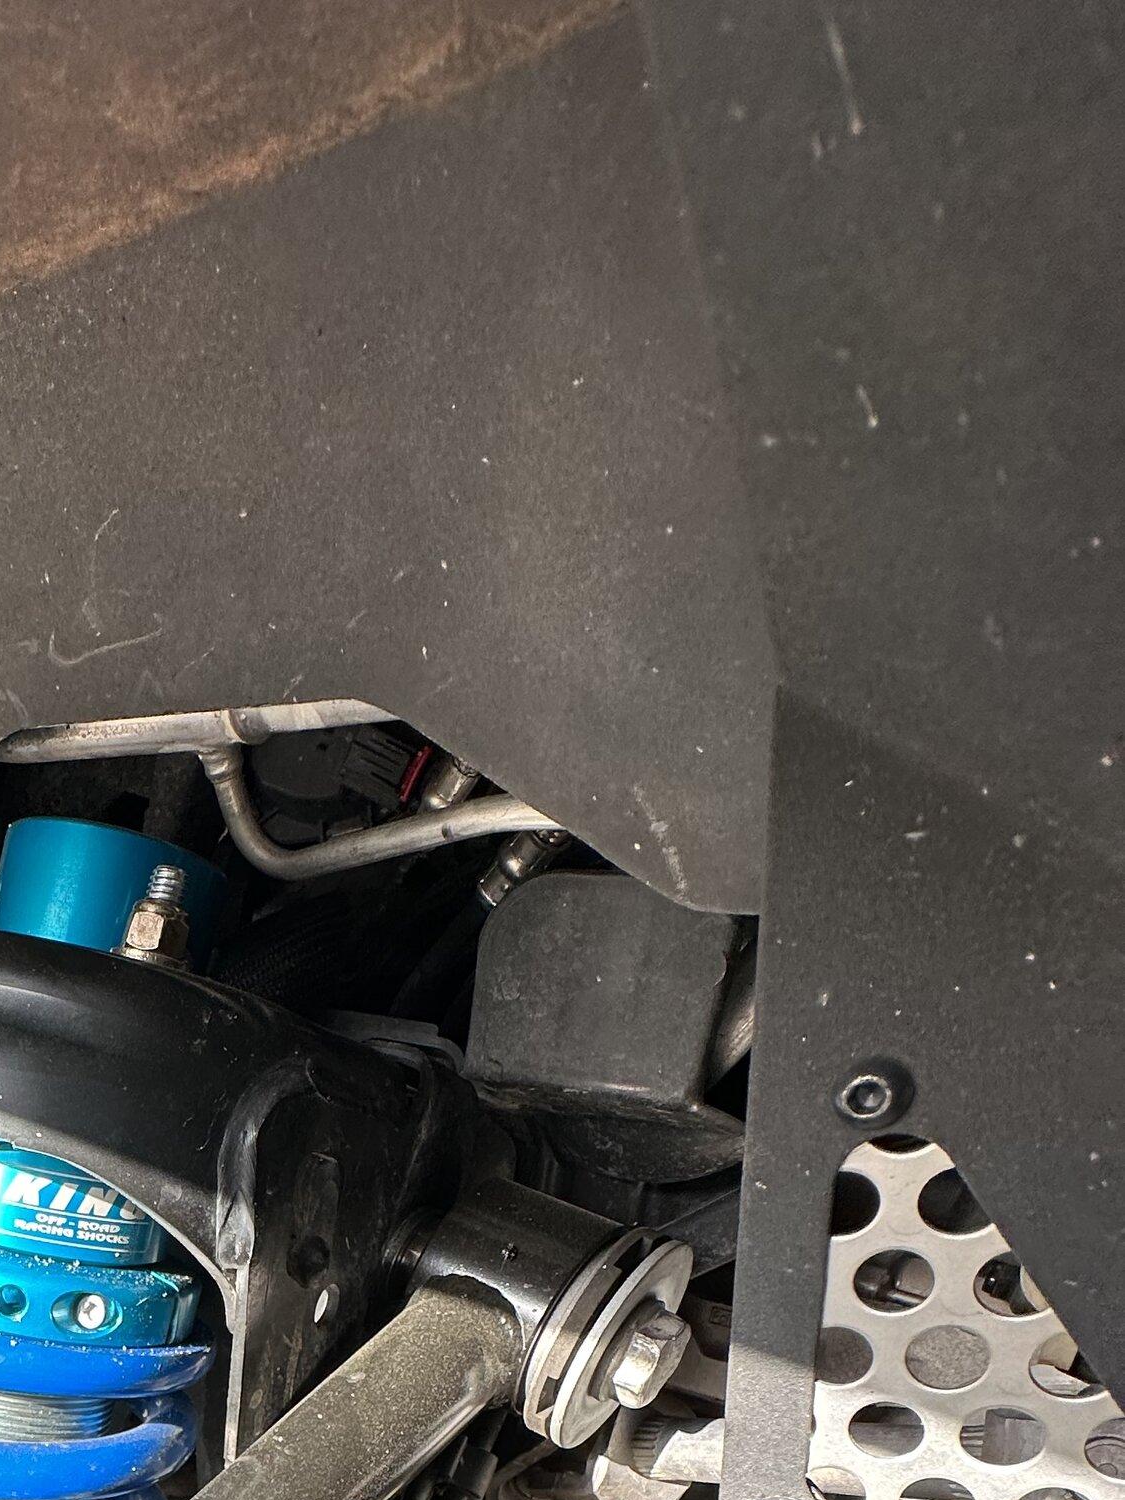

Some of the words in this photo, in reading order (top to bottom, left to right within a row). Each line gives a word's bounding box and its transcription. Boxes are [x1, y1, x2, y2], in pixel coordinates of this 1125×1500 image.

[13, 1218, 74, 1239] RACING
[77, 1230, 130, 1246] SHOCKS
[78, 1220, 121, 1234] ROAD
